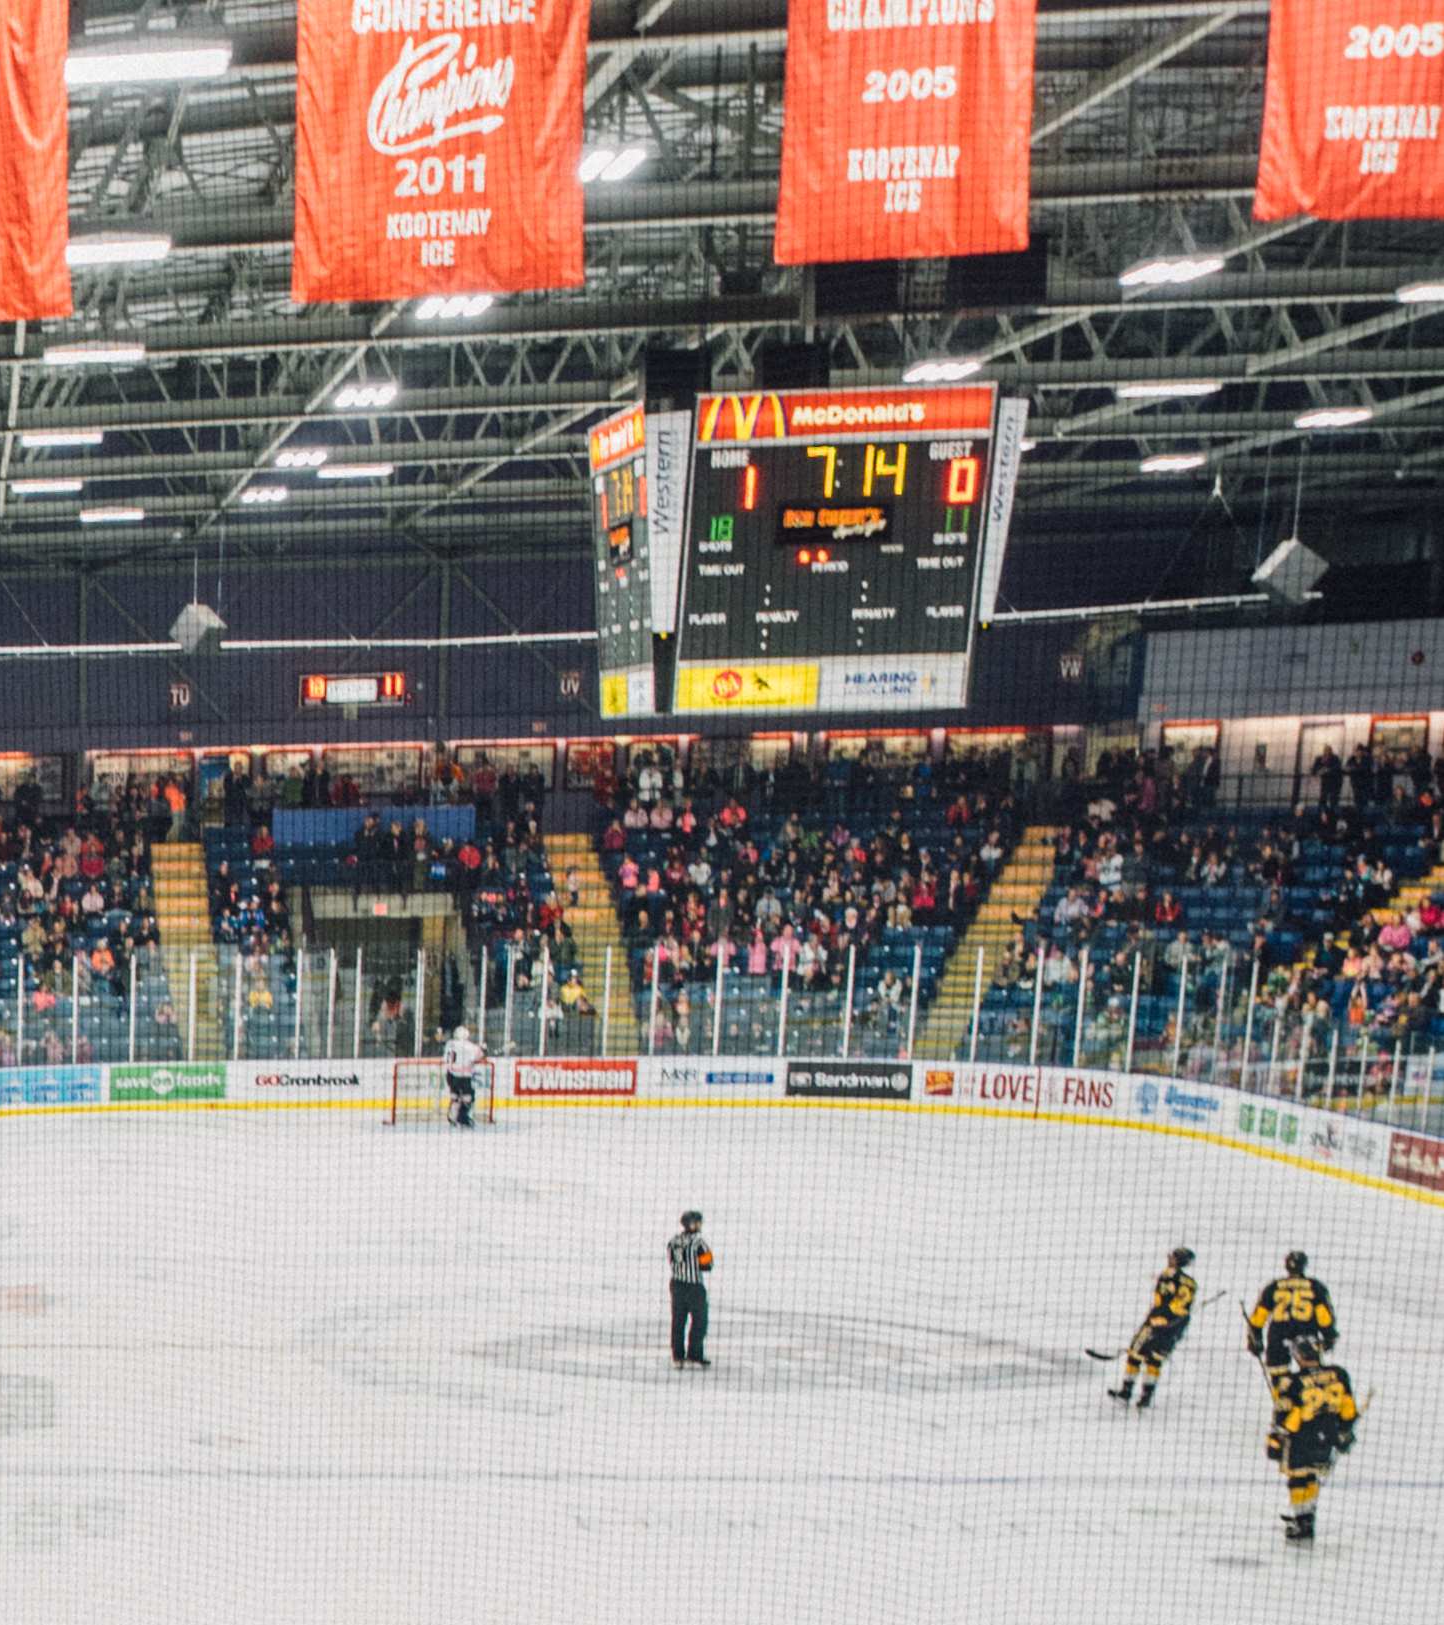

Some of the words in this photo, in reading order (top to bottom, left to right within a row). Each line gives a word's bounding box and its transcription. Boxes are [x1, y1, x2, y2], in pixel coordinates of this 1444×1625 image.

[1345, 22, 1444, 59] 2005
[368, 33, 514, 156] Champions
[862, 66, 958, 103] 2005
[1324, 105, 1441, 141] KOOTENAY
[847, 144, 961, 181] KOOTENAY
[1359, 140, 1400, 175] ICE
[395, 153, 487, 196] 2011
[884, 180, 923, 213] ICE
[386, 208, 492, 241] KOOTENAY
[420, 239, 455, 268] ICE
[791, 402, 926, 427] McDonald's
[711, 449, 750, 469] HOME
[929, 441, 974, 461] GUEST
[653, 429, 671, 535] Western
[743, 464, 758, 511] 1
[946, 456, 979, 503] 0
[711, 515, 734, 541] 18
[933, 532, 968, 545] SHOTS
[698, 540, 733, 553] SHOTS
[755, 610, 799, 623] PENALTY
[852, 607, 896, 620] PENALTY
[1060, 660, 1082, 680] VW
[170, 687, 190, 706] TU
[176, 1072, 221, 1087] foods
[980, 1074, 1034, 1104] LOVE
[1062, 1077, 1115, 1109] FANS
